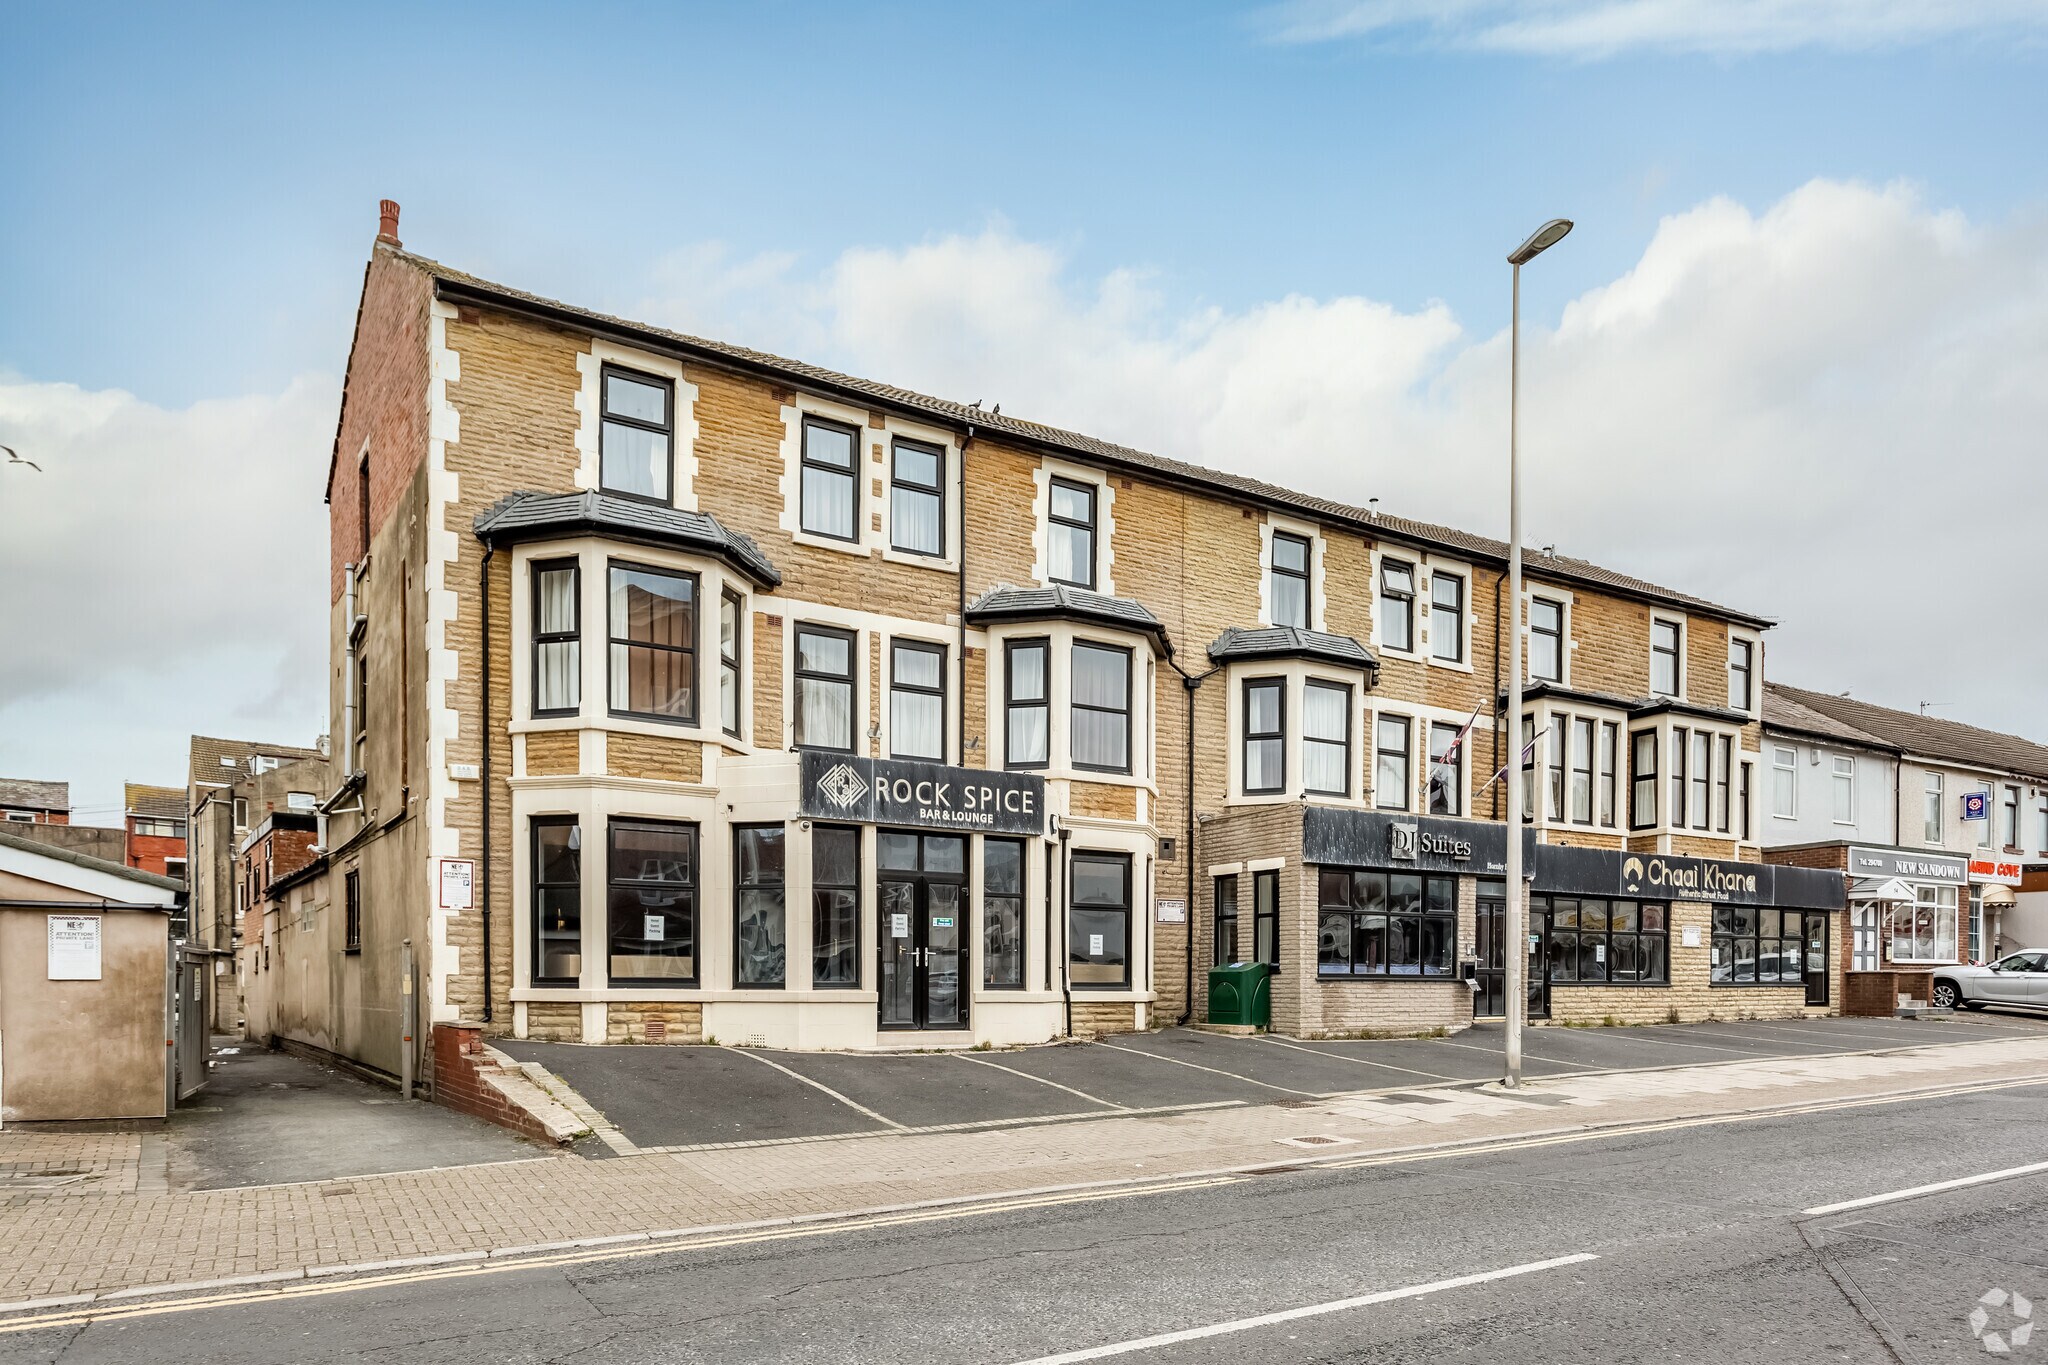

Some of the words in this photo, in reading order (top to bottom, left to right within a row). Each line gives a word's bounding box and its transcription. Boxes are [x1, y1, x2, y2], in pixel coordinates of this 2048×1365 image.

[876, 777, 950, 806] ROCK
[965, 786, 1034, 814] SPICE
[920, 808, 940, 819] BAR
[952, 811, 993, 824] LOUNGE
[1394, 830, 1415, 853] DJ
[1421, 832, 1471, 855] Suites
[1648, 859, 1698, 888] Chaai
[1704, 863, 1756, 892] Khana
[1895, 861, 1916, 874] NEW
[1918, 863, 1960, 878] SANDOWN
[1997, 863, 2019, 878] COVE
